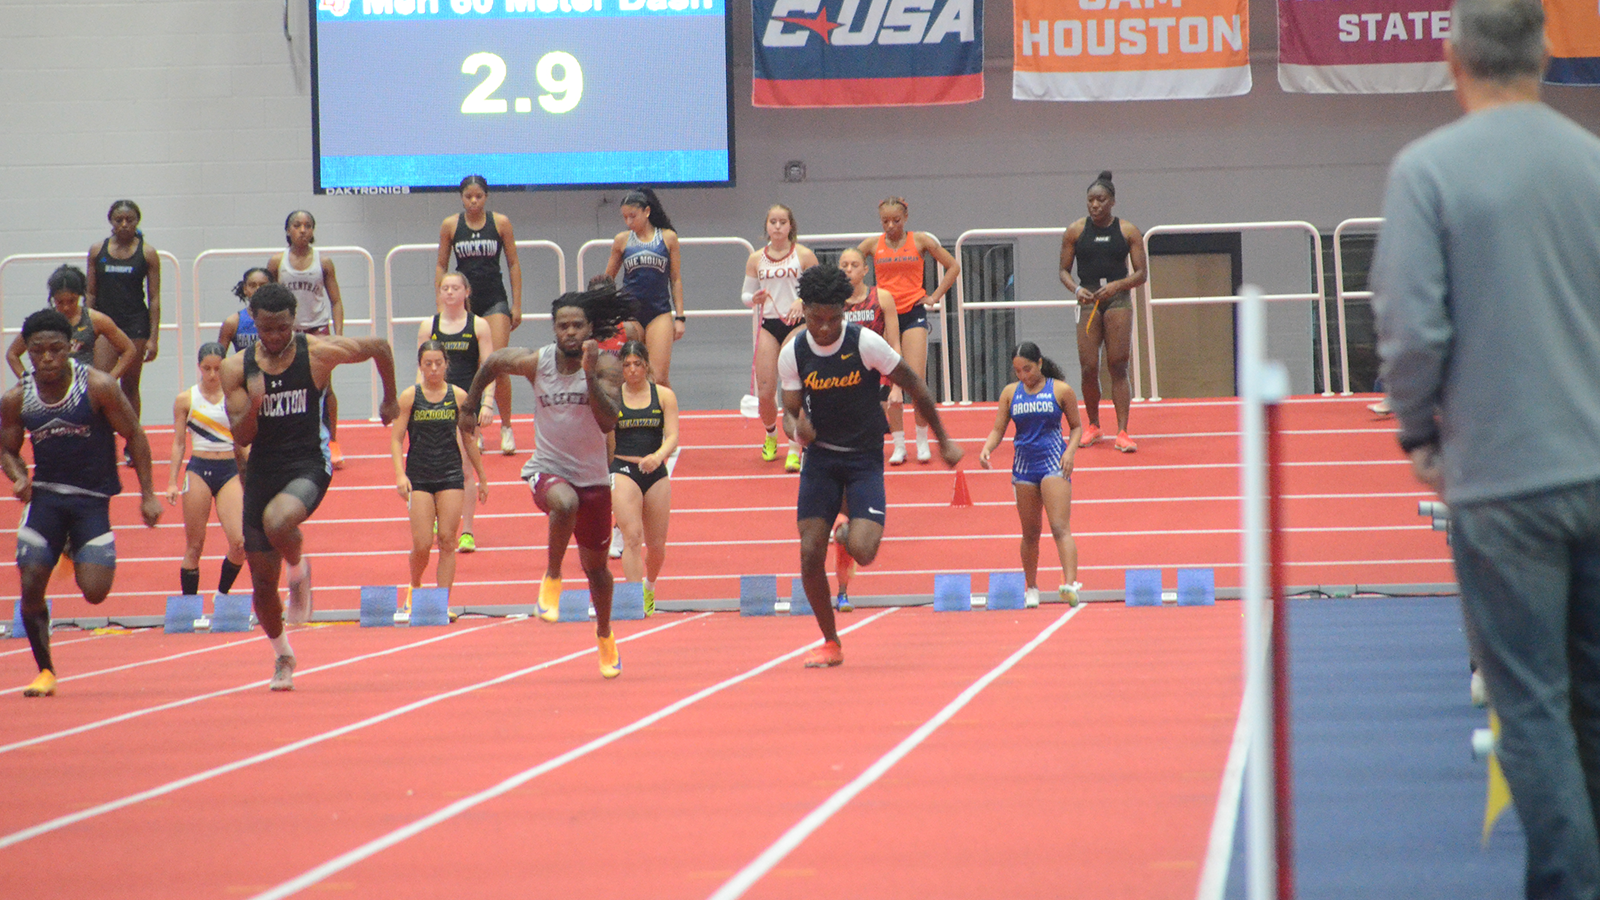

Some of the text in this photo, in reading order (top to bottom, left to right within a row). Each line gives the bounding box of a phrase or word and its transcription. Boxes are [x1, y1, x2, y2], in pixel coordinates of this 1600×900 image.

[1022, 15, 1243, 56] HOUSTON
[1339, 11, 1450, 42] STATE
[460, 51, 584, 114] 2.9
[326, 186, 410, 196] DAKTRONICS
[455, 239, 498, 258] STOCKTON
[759, 268, 798, 280] ELON
[844, 309, 875, 322] NCHBURG
[804, 370, 862, 390] Averett
[259, 388, 307, 417] OCKTON
[1012, 401, 1054, 416] BRONCOS
